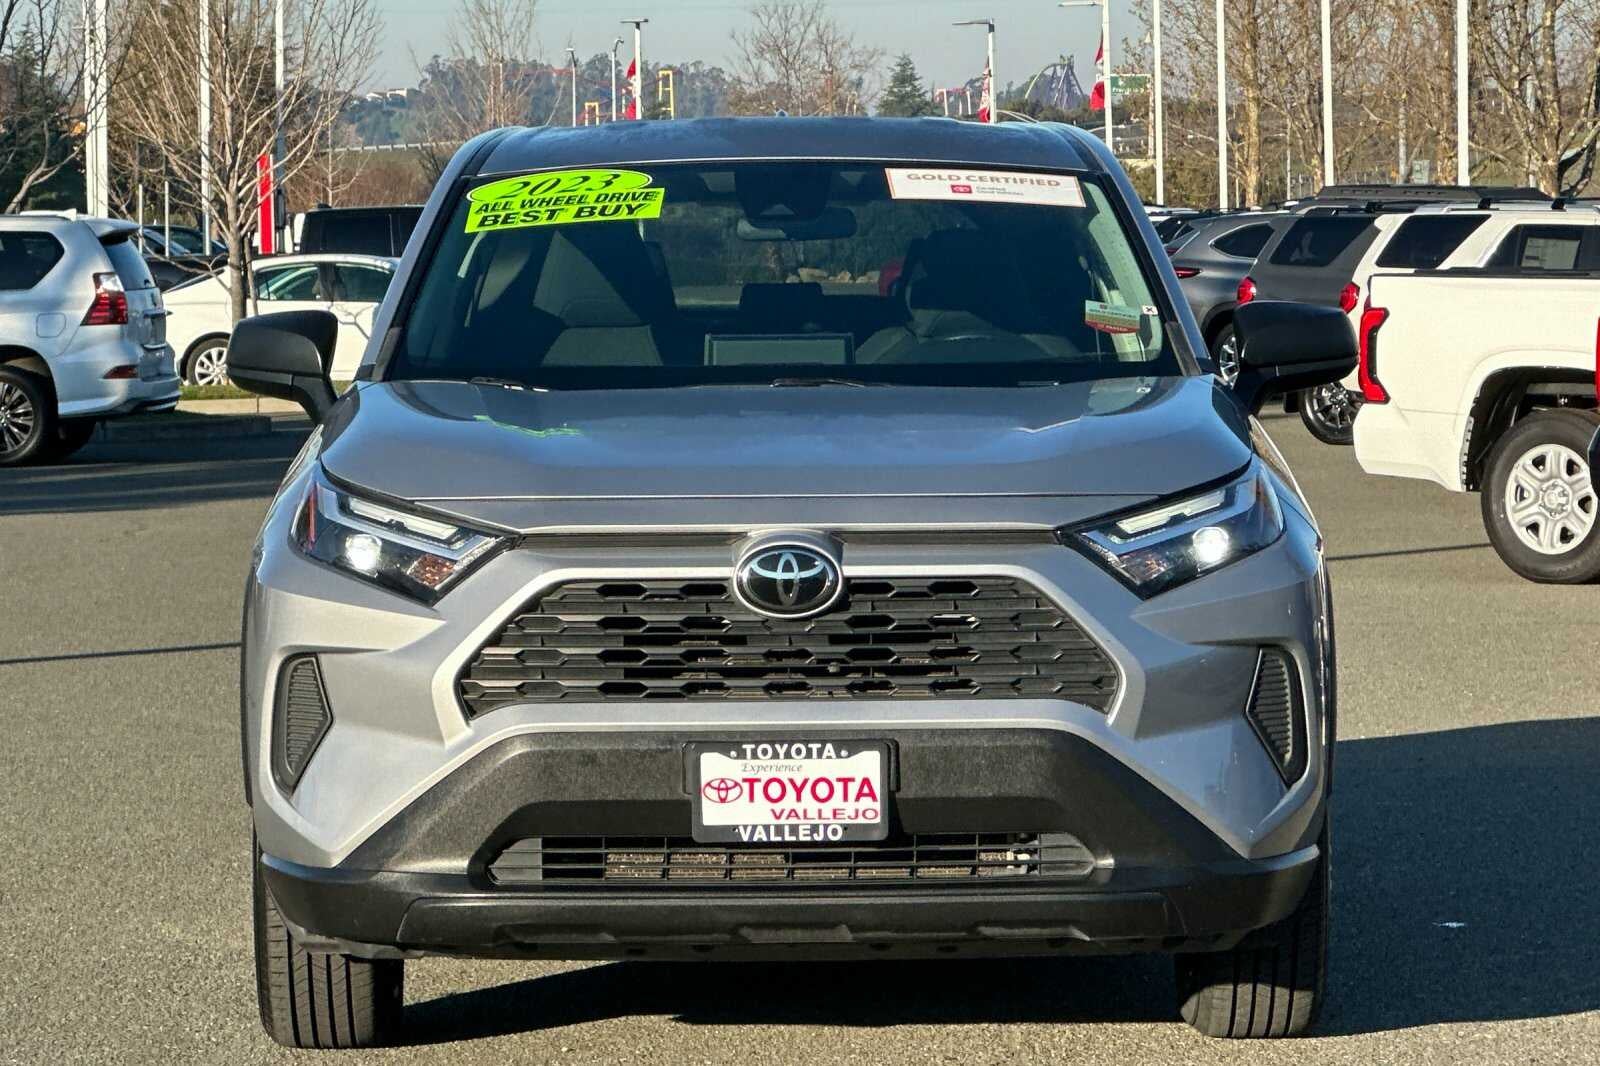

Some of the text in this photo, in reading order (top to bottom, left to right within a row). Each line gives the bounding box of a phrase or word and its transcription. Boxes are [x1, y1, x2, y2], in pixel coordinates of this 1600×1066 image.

[496, 173, 621, 199] 2023
[906, 173, 1061, 187] GOLD CERTIFIED
[475, 190, 658, 214] ALL WHEEL DRIVE
[478, 203, 647, 228] BEST BUY
[742, 743, 836, 760] TOYOTA
[741, 762, 803, 775] Experience
[742, 777, 878, 803] TOYOTA
[770, 808, 879, 820] VALLEJO
[739, 825, 843, 841] VALLEJO
